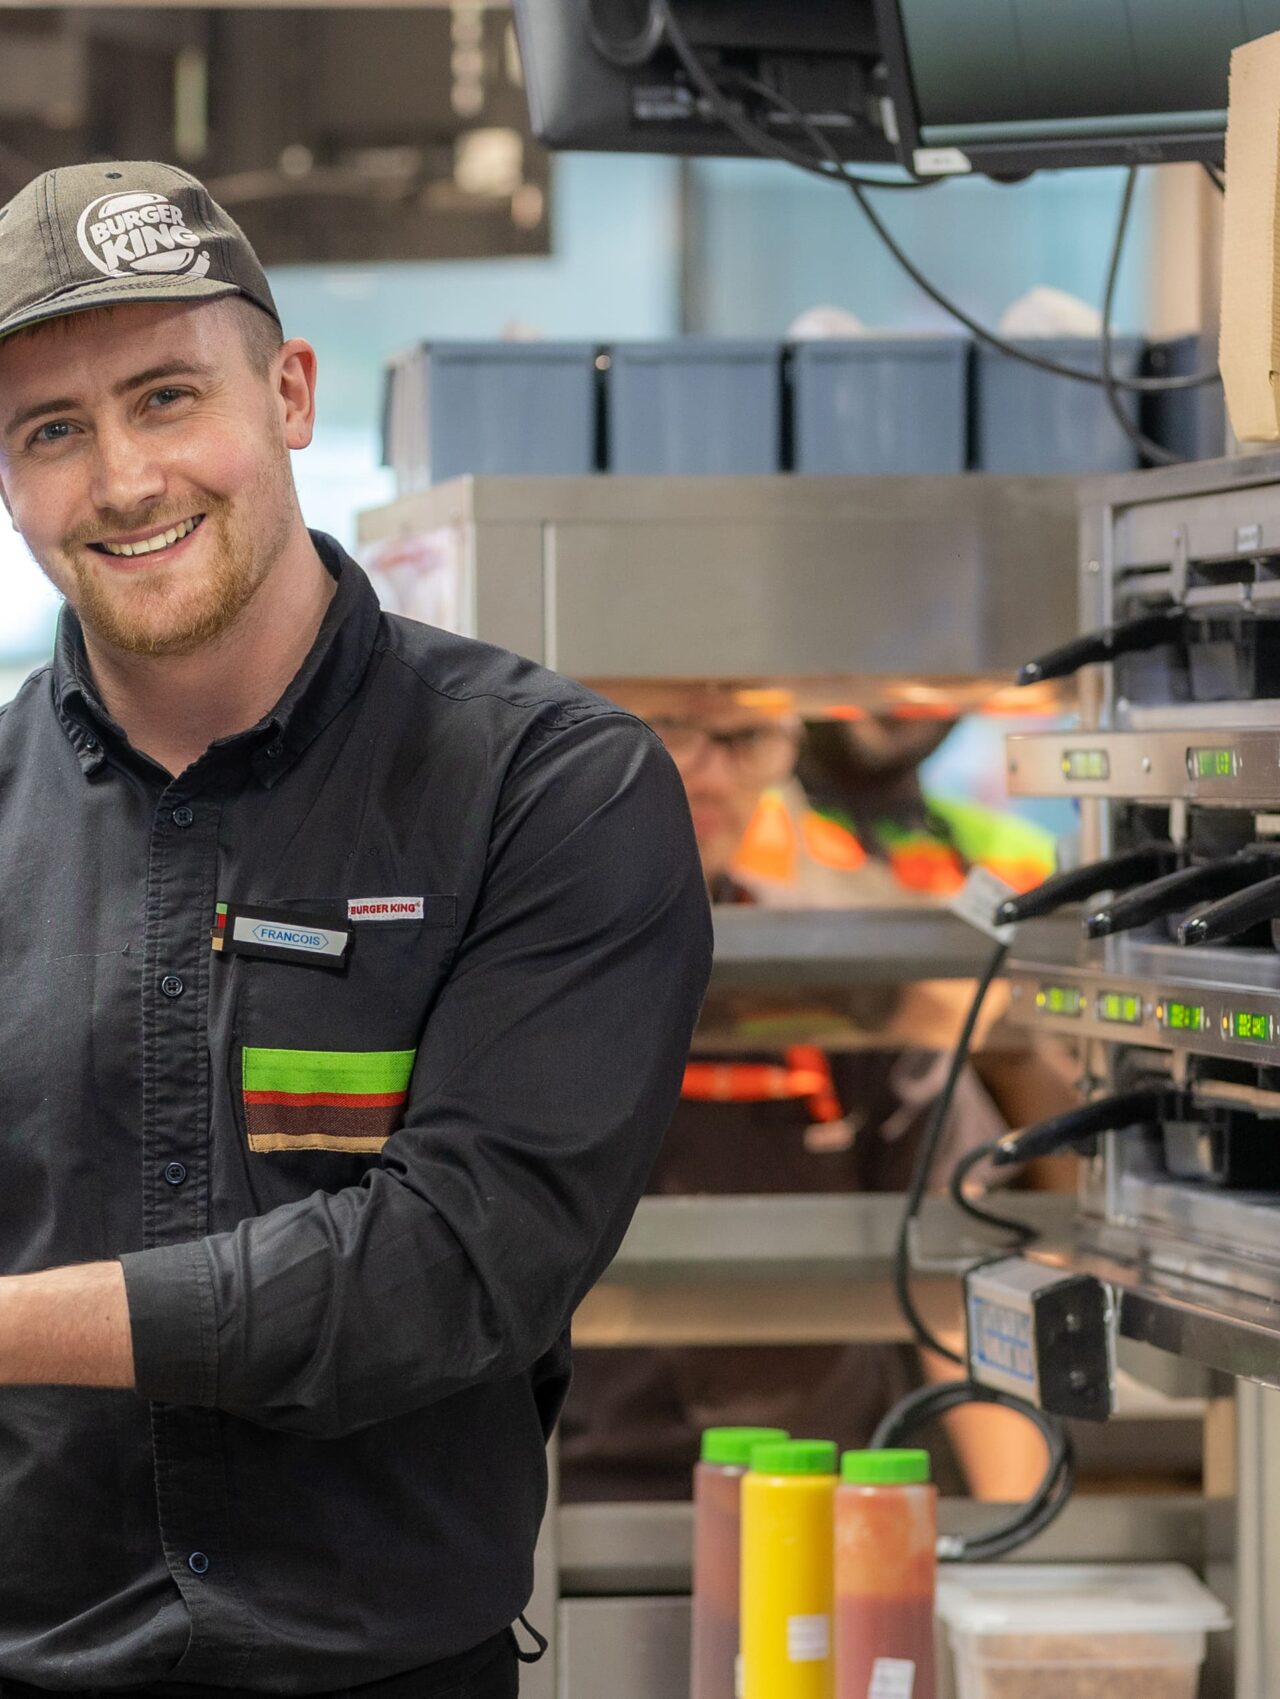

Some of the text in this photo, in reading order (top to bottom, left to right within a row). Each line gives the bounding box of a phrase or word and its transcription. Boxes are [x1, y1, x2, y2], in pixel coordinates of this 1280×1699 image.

[90, 205, 185, 245] BURGER
[101, 224, 200, 270] KING
[350, 904, 388, 915] BURGER
[261, 928, 320, 945] FRANCOIS
